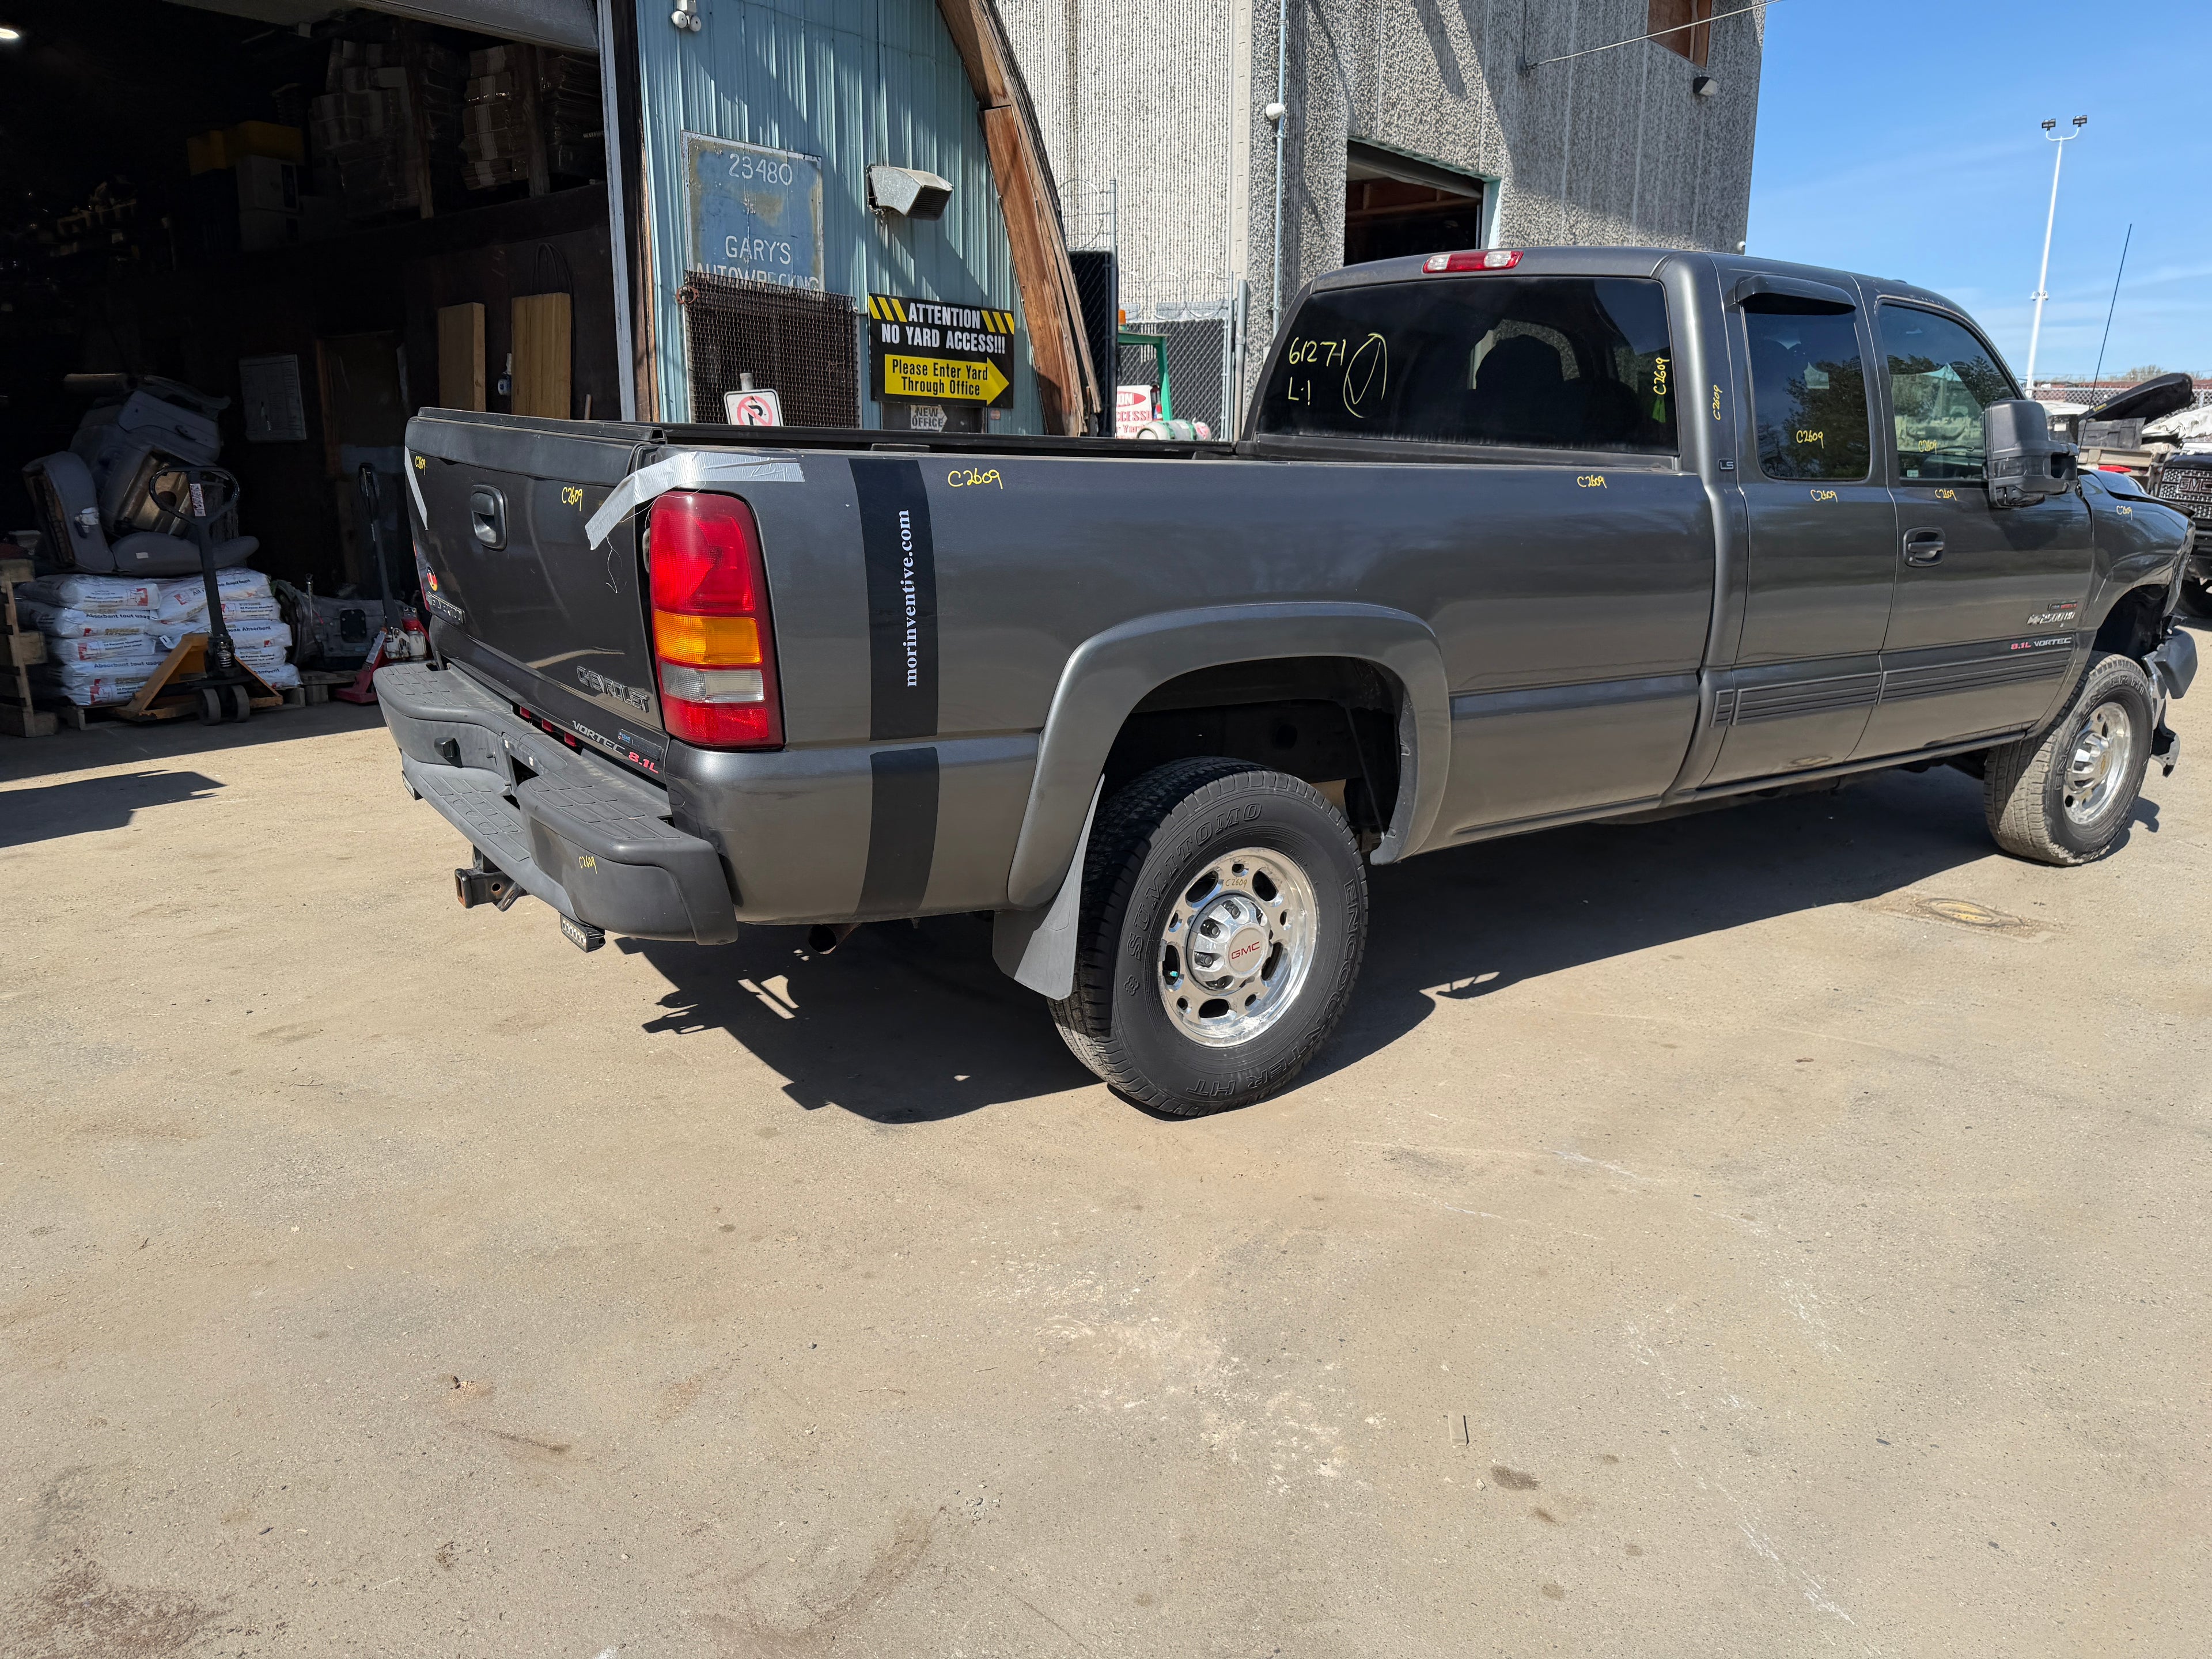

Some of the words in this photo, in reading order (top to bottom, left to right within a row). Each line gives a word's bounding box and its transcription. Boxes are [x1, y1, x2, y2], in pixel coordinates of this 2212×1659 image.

[729, 153, 793, 185] 23480
[725, 236, 791, 265] GARY'S
[908, 302, 980, 329] ATTENTION
[881, 323, 900, 344] NO
[905, 326, 940, 348] YARD
[945, 331, 1005, 354] ACCESS!!!
[892, 359, 928, 376] Please
[933, 362, 961, 379] Enter
[966, 365, 988, 381] Yard
[1653, 357, 1670, 395] C2609
[901, 376, 945, 396] Through
[950, 379, 980, 396] Office
[916, 407, 938, 416] NEW
[1713, 384, 1723, 421] C2609
[912, 415, 943, 427] OFFICE
[1796, 430, 1824, 449] C2609
[1720, 461, 1733, 469] LS
[948, 467, 1003, 489] C2609
[1577, 475, 1607, 488] C2609
[562, 486, 582, 512] C2609
[1810, 490, 1838, 503] C2609
[899, 509, 917, 687] morinventive.com
[2011, 642, 2031, 650] 8.1L
[2034, 637, 2072, 646] VORTEC
[577, 665, 650, 713] CHEVROLET
[573, 720, 625, 755] VORTEC
[628, 751, 658, 774] 8.1L
[579, 855, 597, 874] C2609
[1127, 802, 1262, 961] SUMITOMO
[1225, 878, 1248, 889] C2609
[1231, 941, 1260, 960] GMC
[1186, 1078, 1236, 1097] HT
